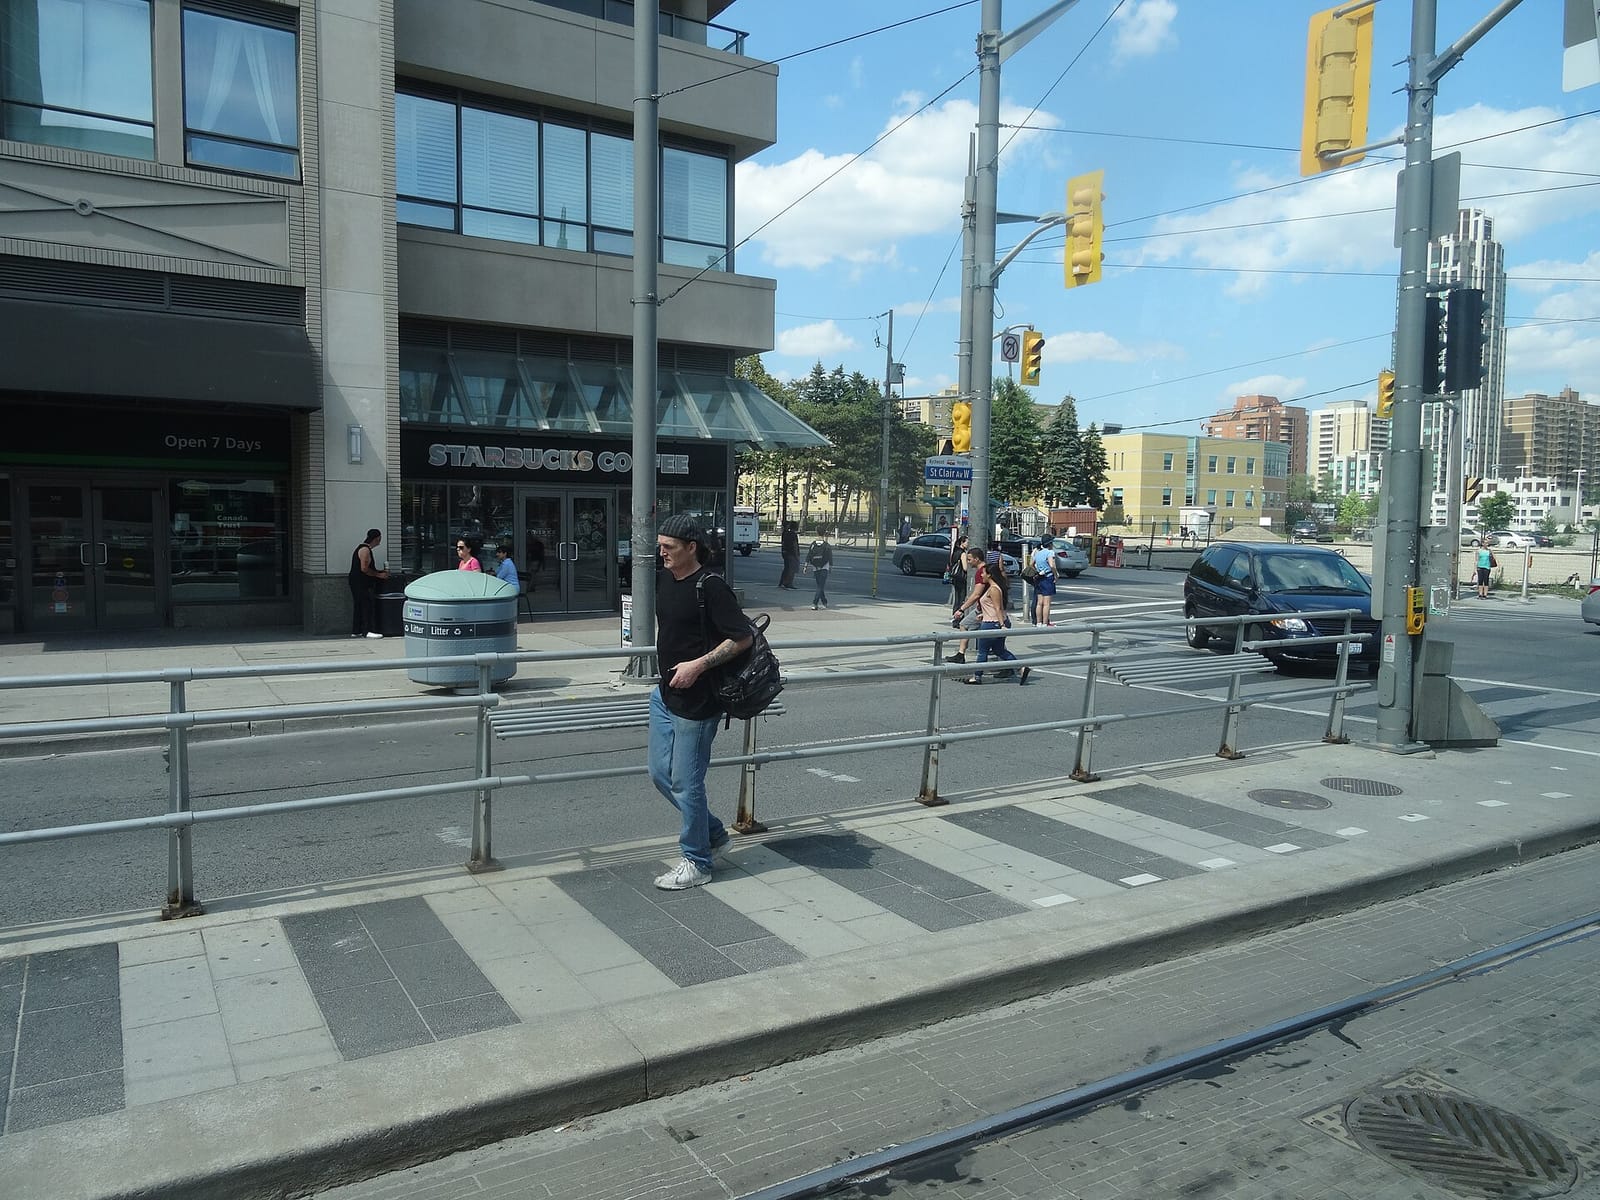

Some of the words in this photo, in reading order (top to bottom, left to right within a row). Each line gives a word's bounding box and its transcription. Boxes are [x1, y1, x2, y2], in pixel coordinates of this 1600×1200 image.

[164, 434, 207, 451] Open
[211, 436, 220, 449] 7
[225, 437, 262, 453] Days
[428, 443, 594, 471] STARBUCKS
[597, 451, 689, 475] COEE
[930, 467, 937, 477] St
[938, 468, 955, 479] Clair
[963, 469, 970, 479] W
[216, 521, 241, 529] Trust
[410, 623, 425, 634] Litter
[431, 626, 450, 636] Litter
